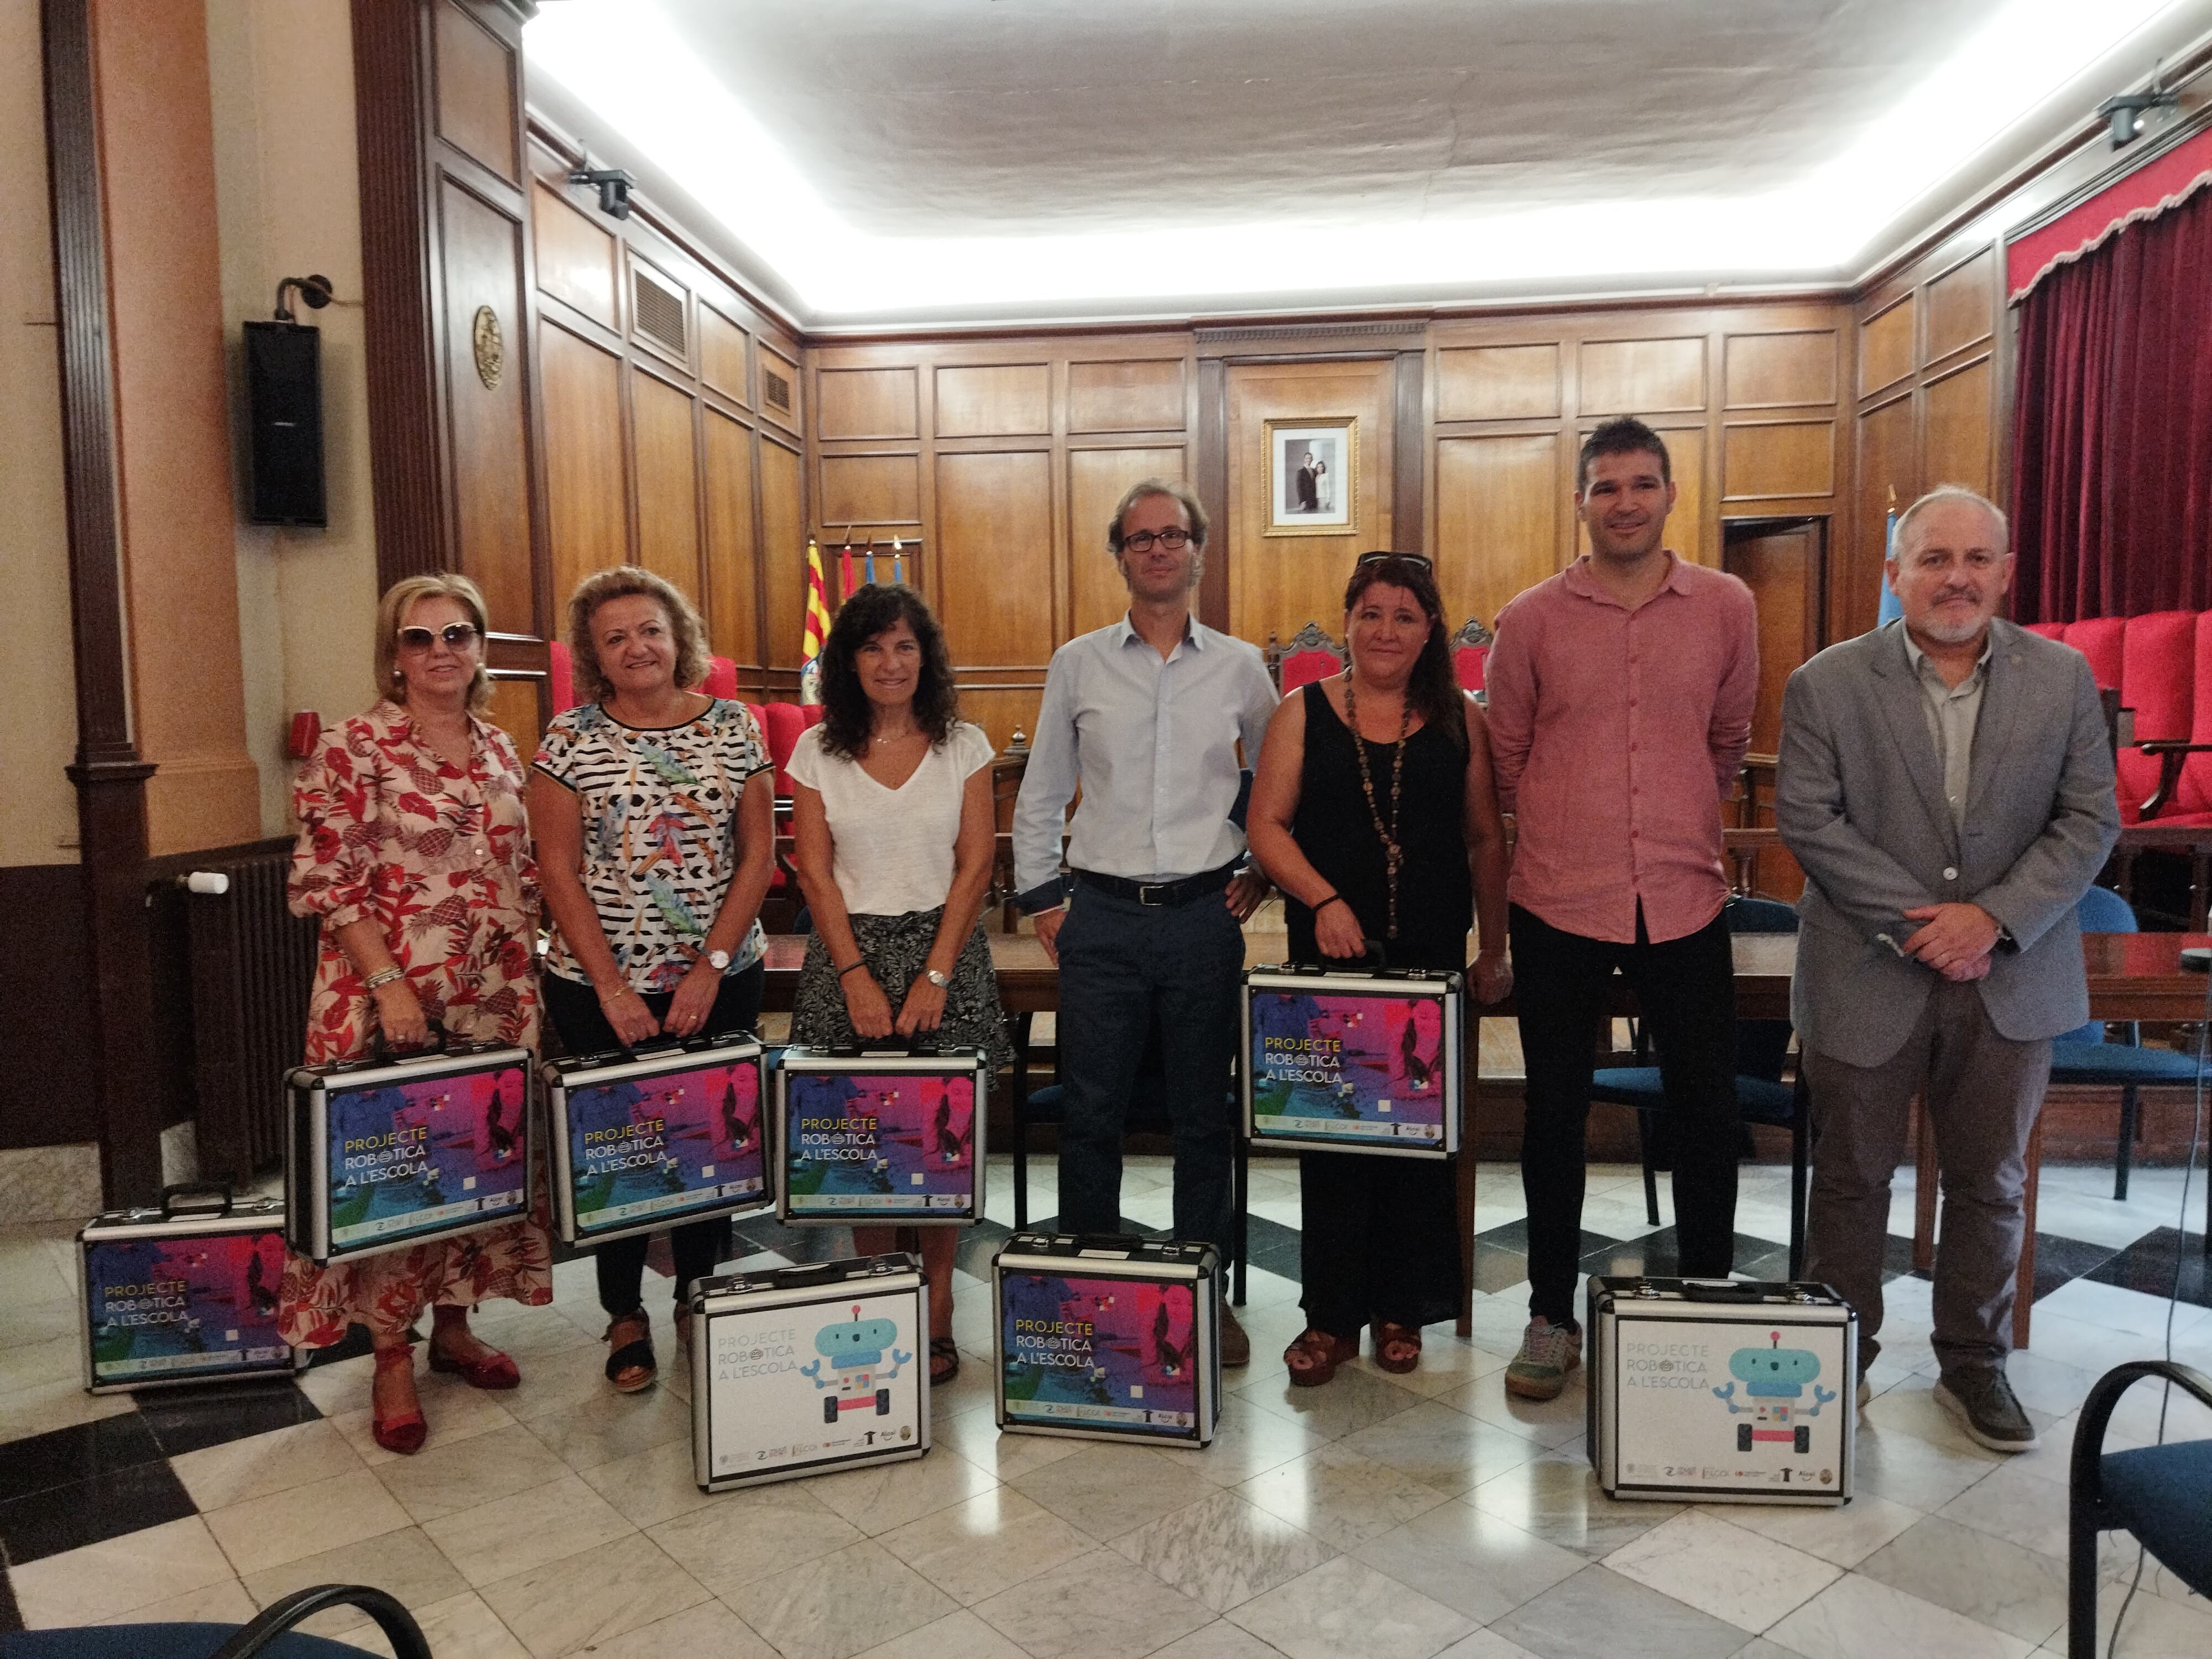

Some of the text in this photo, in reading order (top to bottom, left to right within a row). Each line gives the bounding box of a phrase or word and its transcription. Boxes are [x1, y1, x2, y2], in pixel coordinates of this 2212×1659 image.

[1265, 1037, 1341, 1052] PROJECTE
[1265, 1070, 1343, 1083] A L'ESCOLA
[585, 1120, 664, 1144] PROJECTE
[801, 1118, 877, 1130] PROJECTE
[345, 1127, 427, 1153] PROJECTE
[801, 1149, 878, 1160] A L'ESCOLA
[587, 1151, 668, 1176] A L'ESCOLA
[345, 1161, 430, 1188] A L'ESCOLA
[105, 1281, 186, 1297] PROJECTE
[107, 1311, 188, 1328] A L'ESCOLA
[1016, 1319, 1093, 1336] PROJECTE
[719, 1328, 796, 1348] PROJECTE
[1627, 1343, 1709, 1357] PROJECTE
[1016, 1353, 1095, 1368] A L'ESCOLA
[719, 1360, 797, 1381] A L'ESCOLA
[1626, 1376, 1709, 1389] A L'ESCOLA
